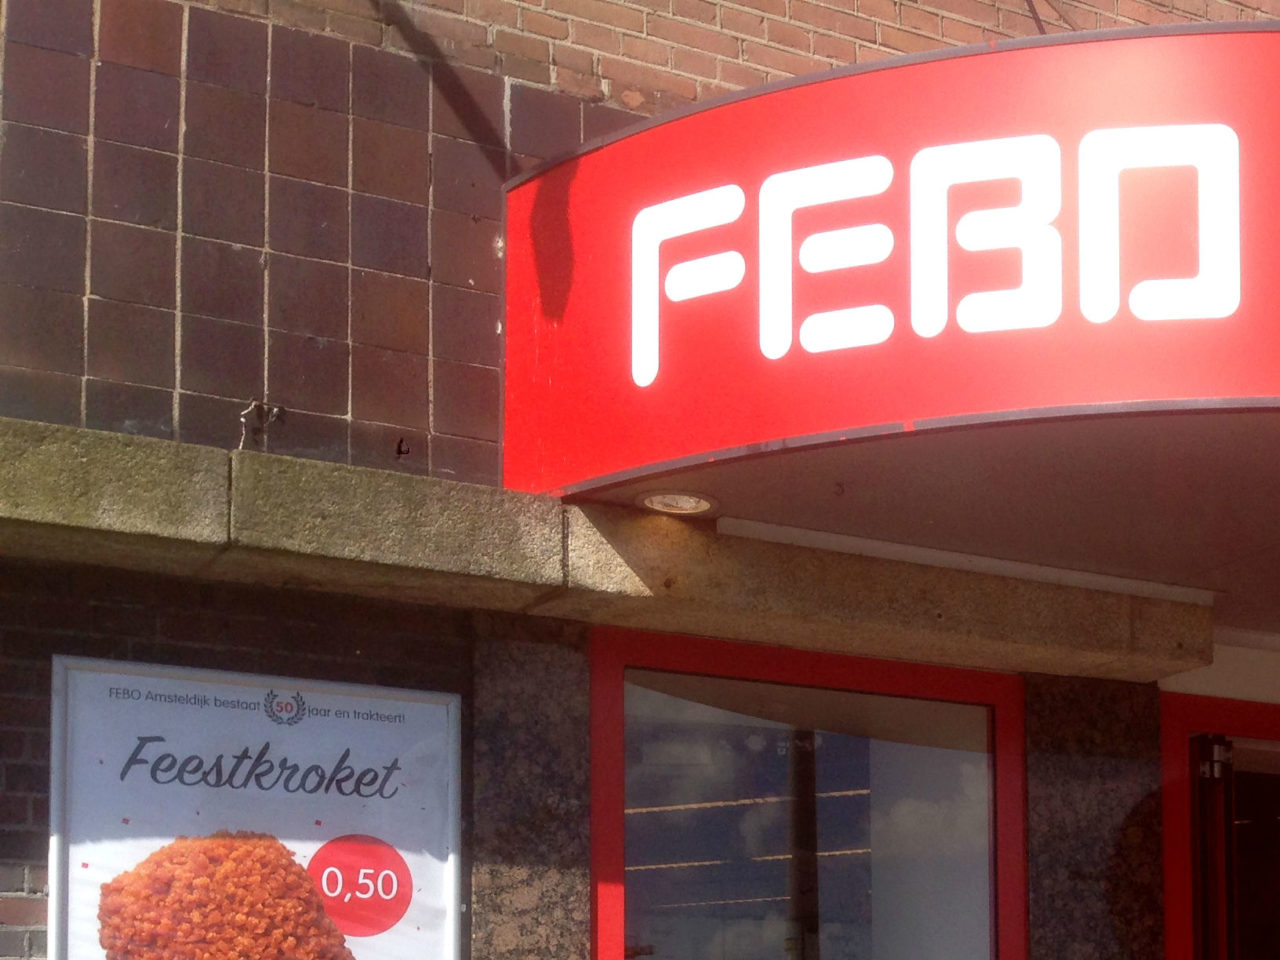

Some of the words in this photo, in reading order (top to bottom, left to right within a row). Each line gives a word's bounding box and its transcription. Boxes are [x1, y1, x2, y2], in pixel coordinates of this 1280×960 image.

[632, 123, 1241, 387] FEBO
[108, 687, 142, 701] FEBO
[144, 690, 210, 709] Amsteldijk
[213, 696, 261, 711] bestaat
[275, 701, 294, 713] 50
[308, 706, 331, 718] jaar
[335, 710, 350, 719] en
[119, 734, 403, 801] Feestkroket
[321, 866, 399, 903] 0,50
